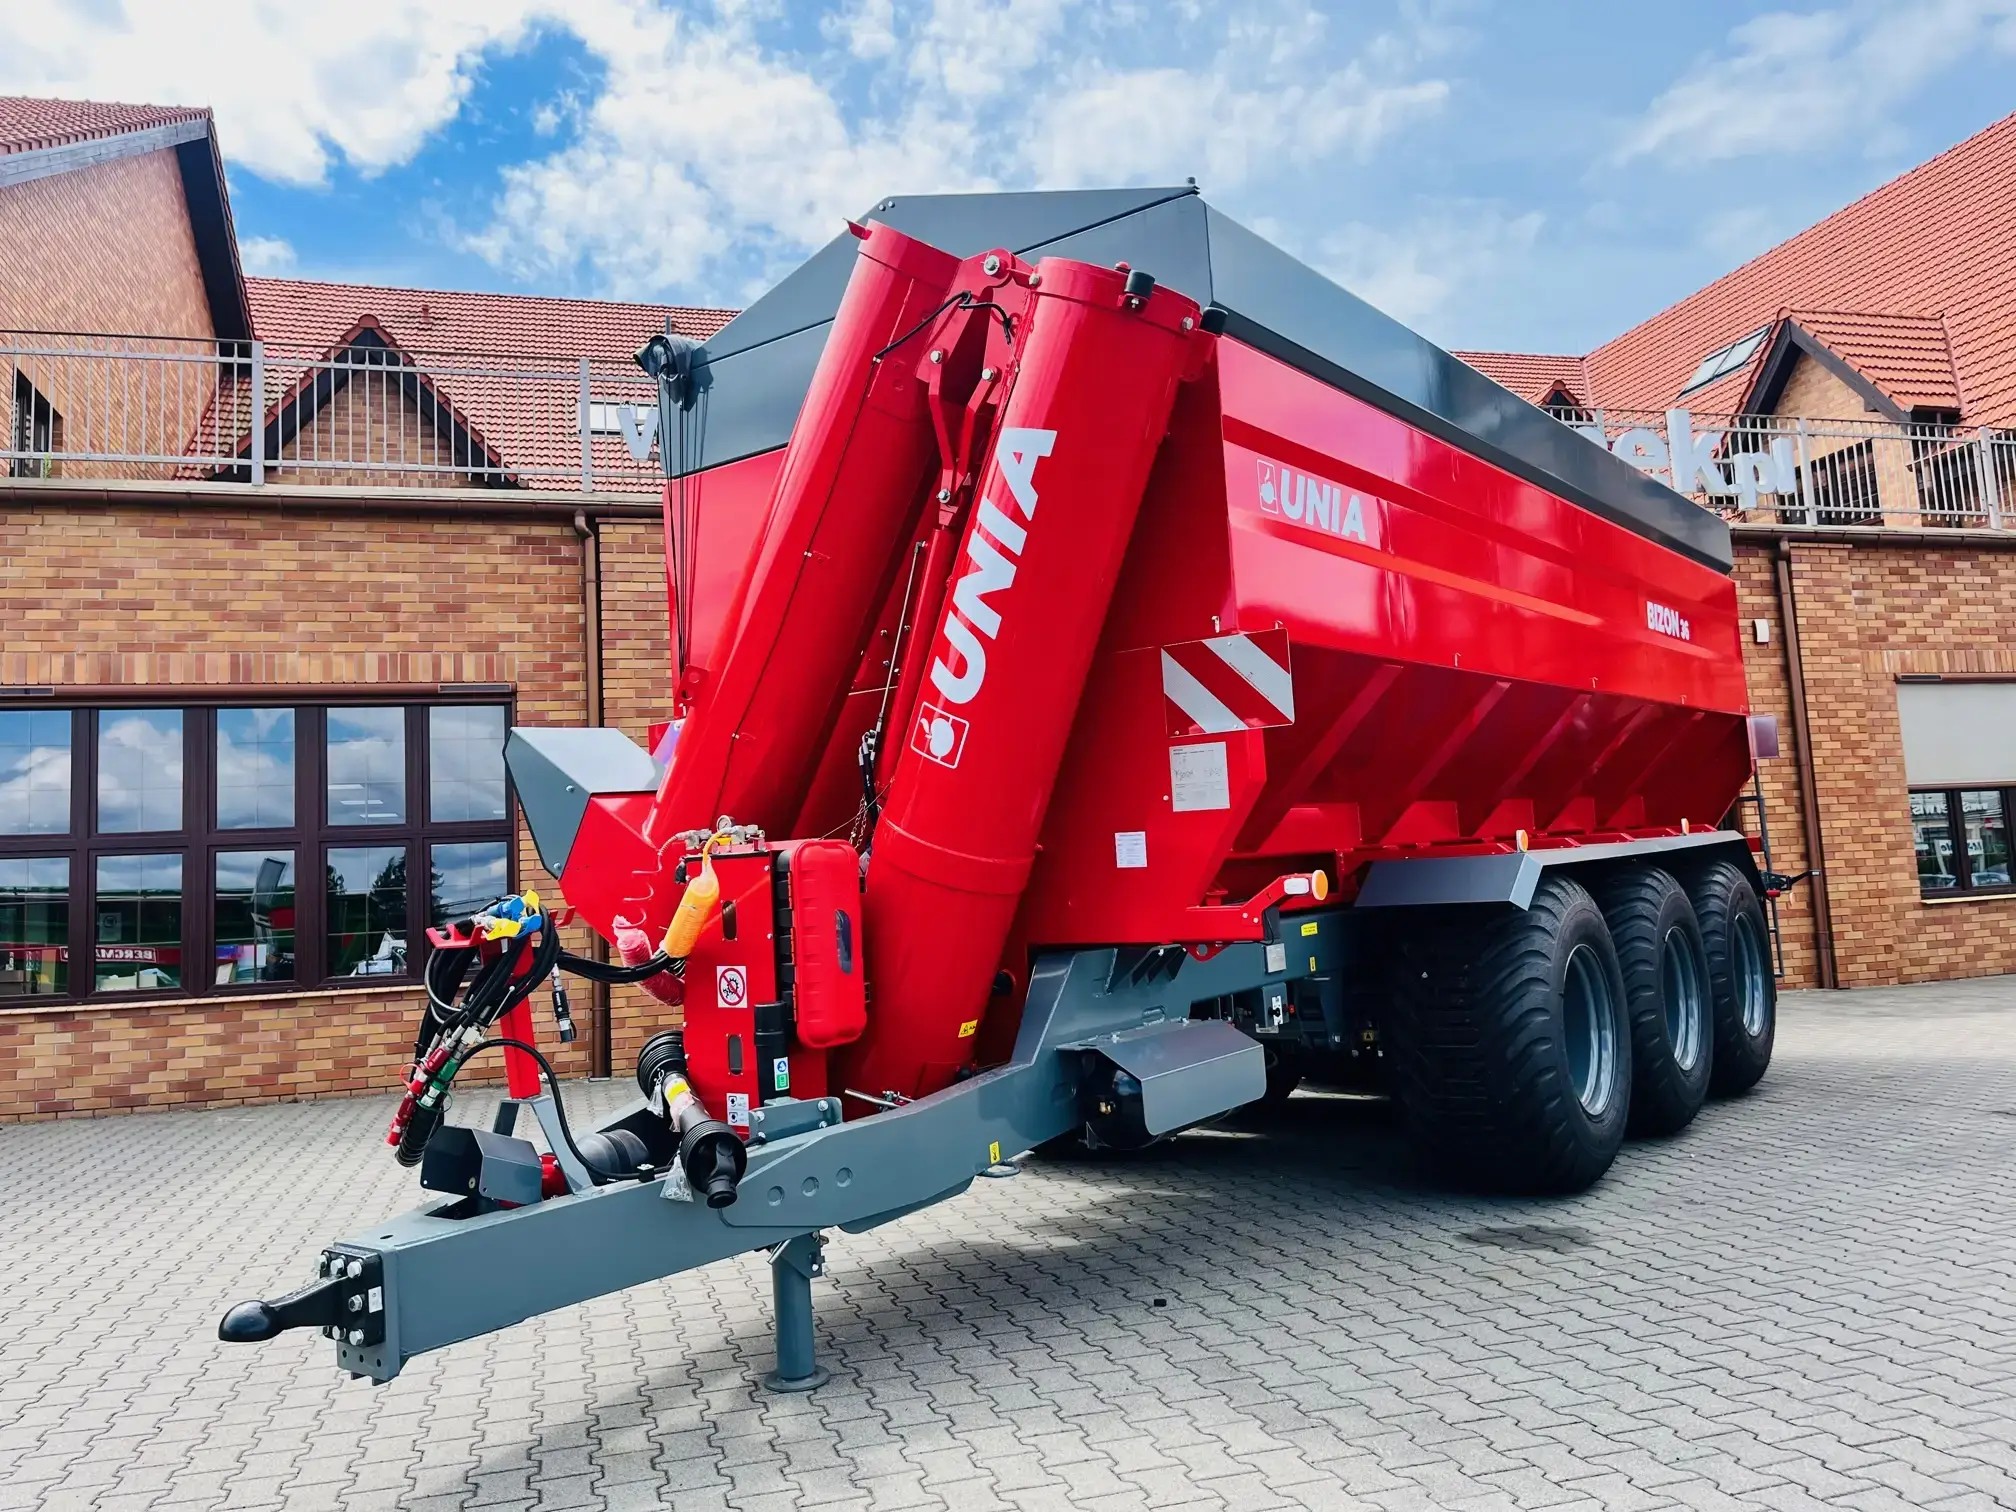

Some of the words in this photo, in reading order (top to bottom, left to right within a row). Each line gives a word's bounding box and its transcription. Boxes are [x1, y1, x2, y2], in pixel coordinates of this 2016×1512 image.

[1281, 468, 1367, 542] UNIA
[930, 427, 1058, 704] UNIA
[1646, 600, 1681, 638] BIZON
